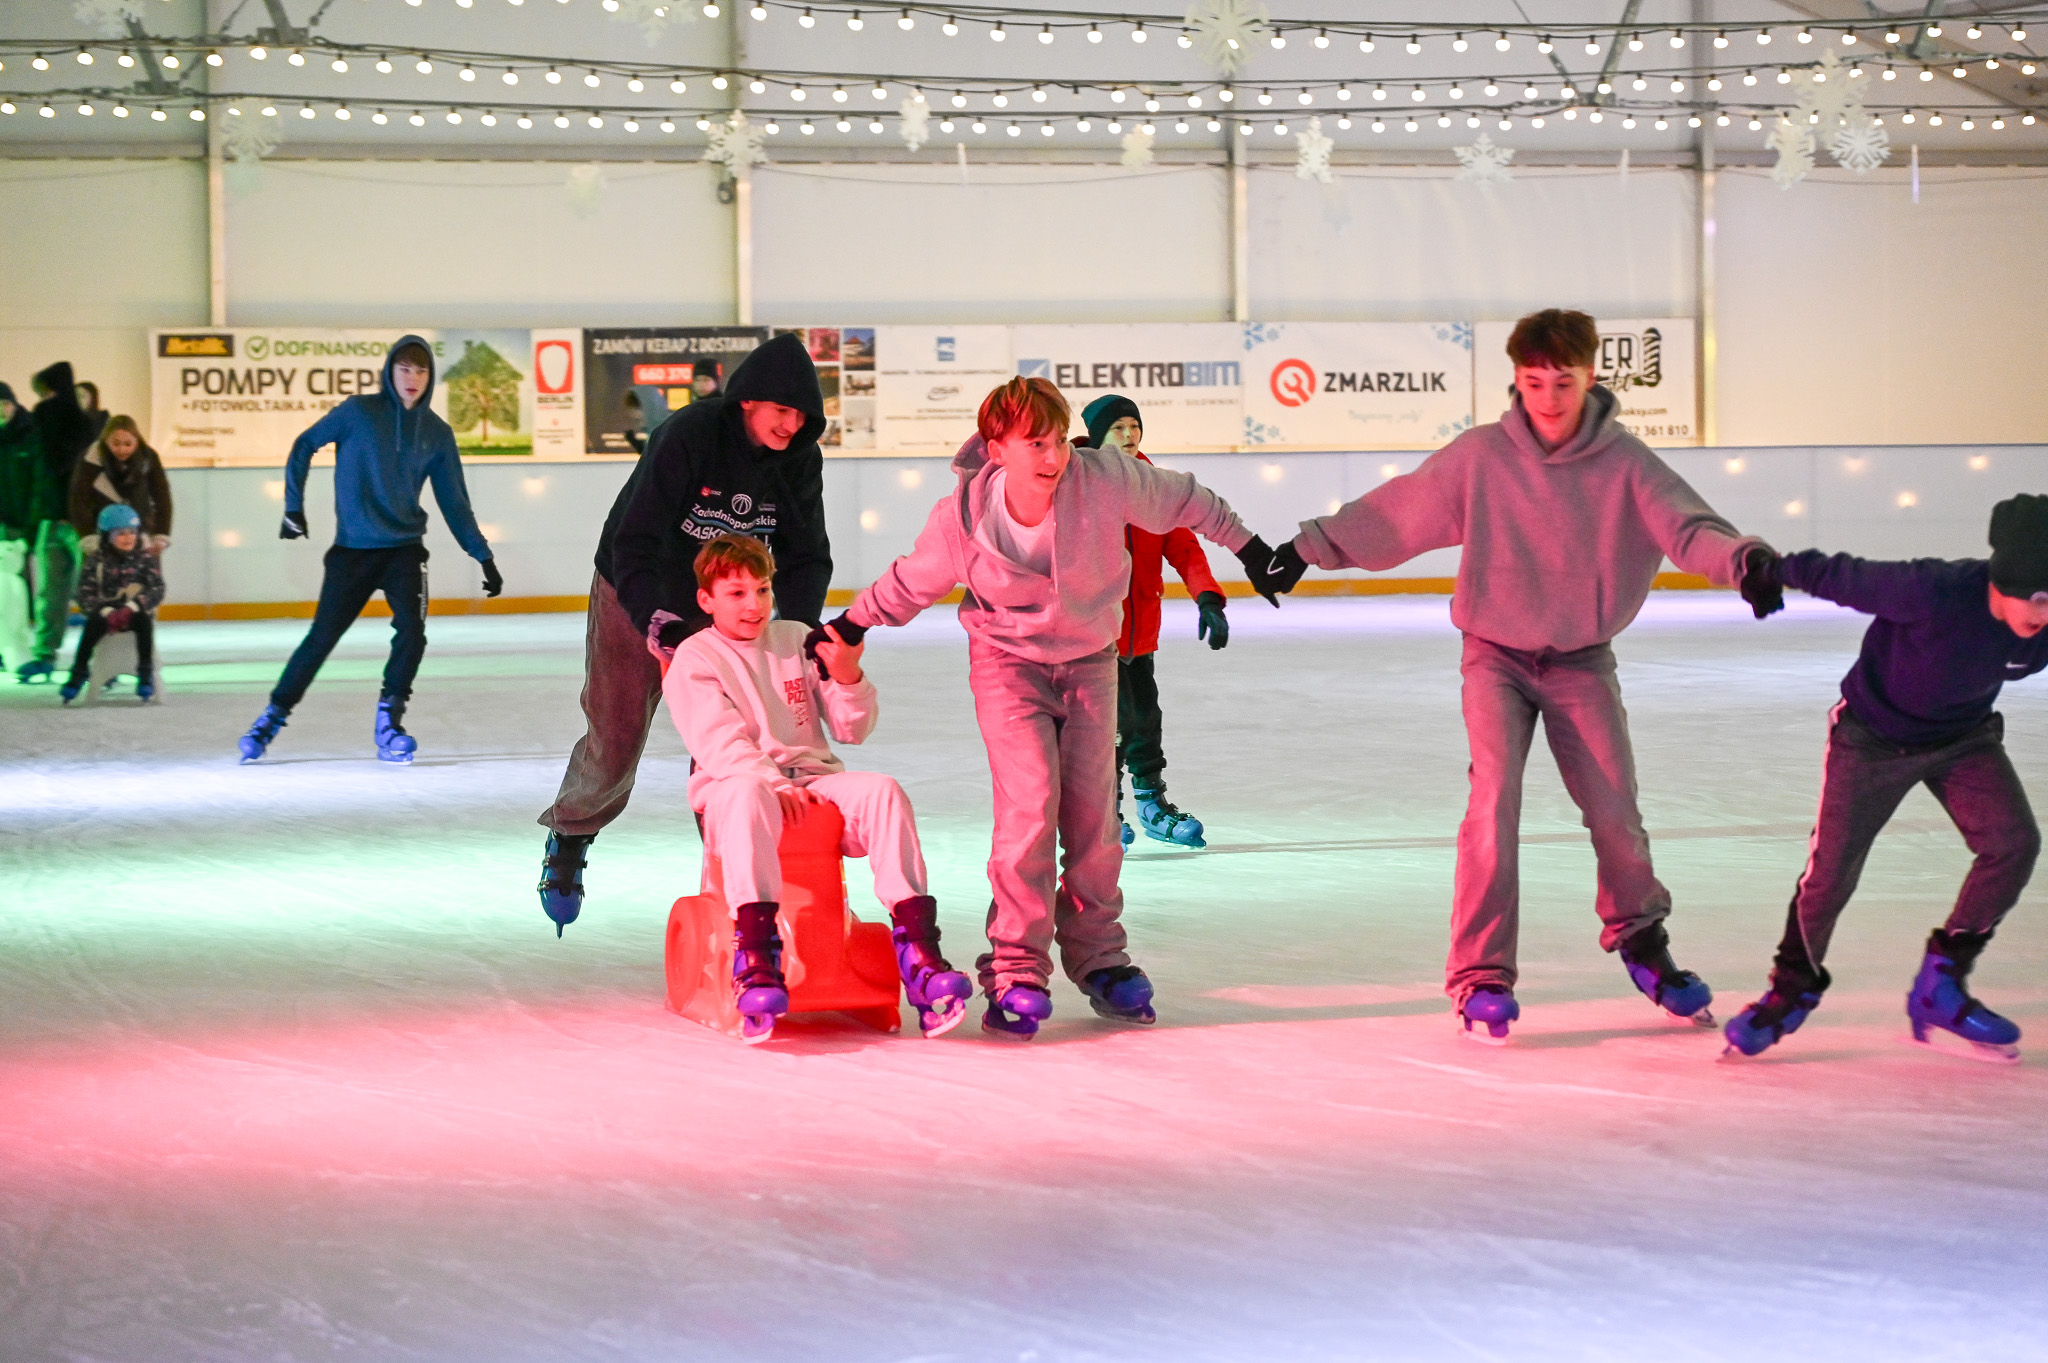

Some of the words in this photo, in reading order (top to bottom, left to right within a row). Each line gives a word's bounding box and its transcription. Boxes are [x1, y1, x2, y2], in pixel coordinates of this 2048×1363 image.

[181, 367, 296, 395] POMPY
[1056, 361, 1240, 388] ELEKTROBIM
[1324, 372, 1447, 392] ZMARZLIK
[192, 400, 304, 411] FOTOWOLTAIKA
[1644, 425, 1664, 436] 361
[1667, 424, 1689, 435] 810
